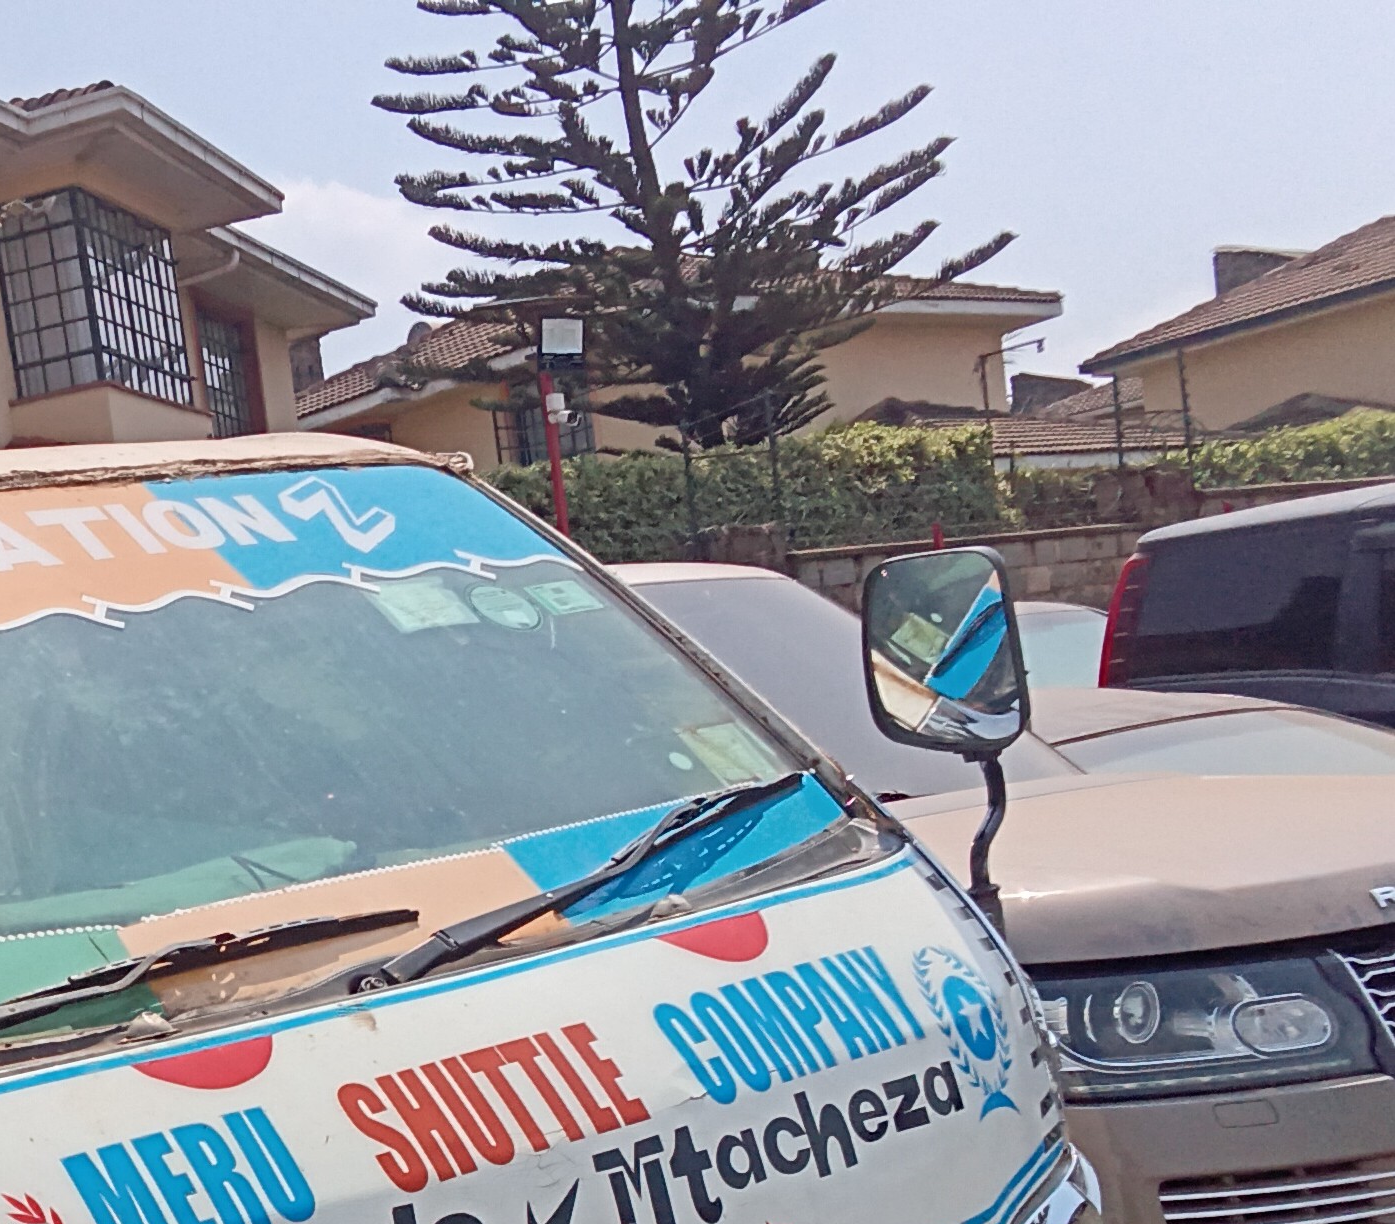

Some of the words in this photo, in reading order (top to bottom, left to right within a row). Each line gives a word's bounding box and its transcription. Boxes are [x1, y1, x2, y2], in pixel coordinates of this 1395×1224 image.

[278, 475, 396, 554] Z
[337, 1022, 651, 1193] SHUTTLE
[652, 945, 926, 1105] COMPANY
